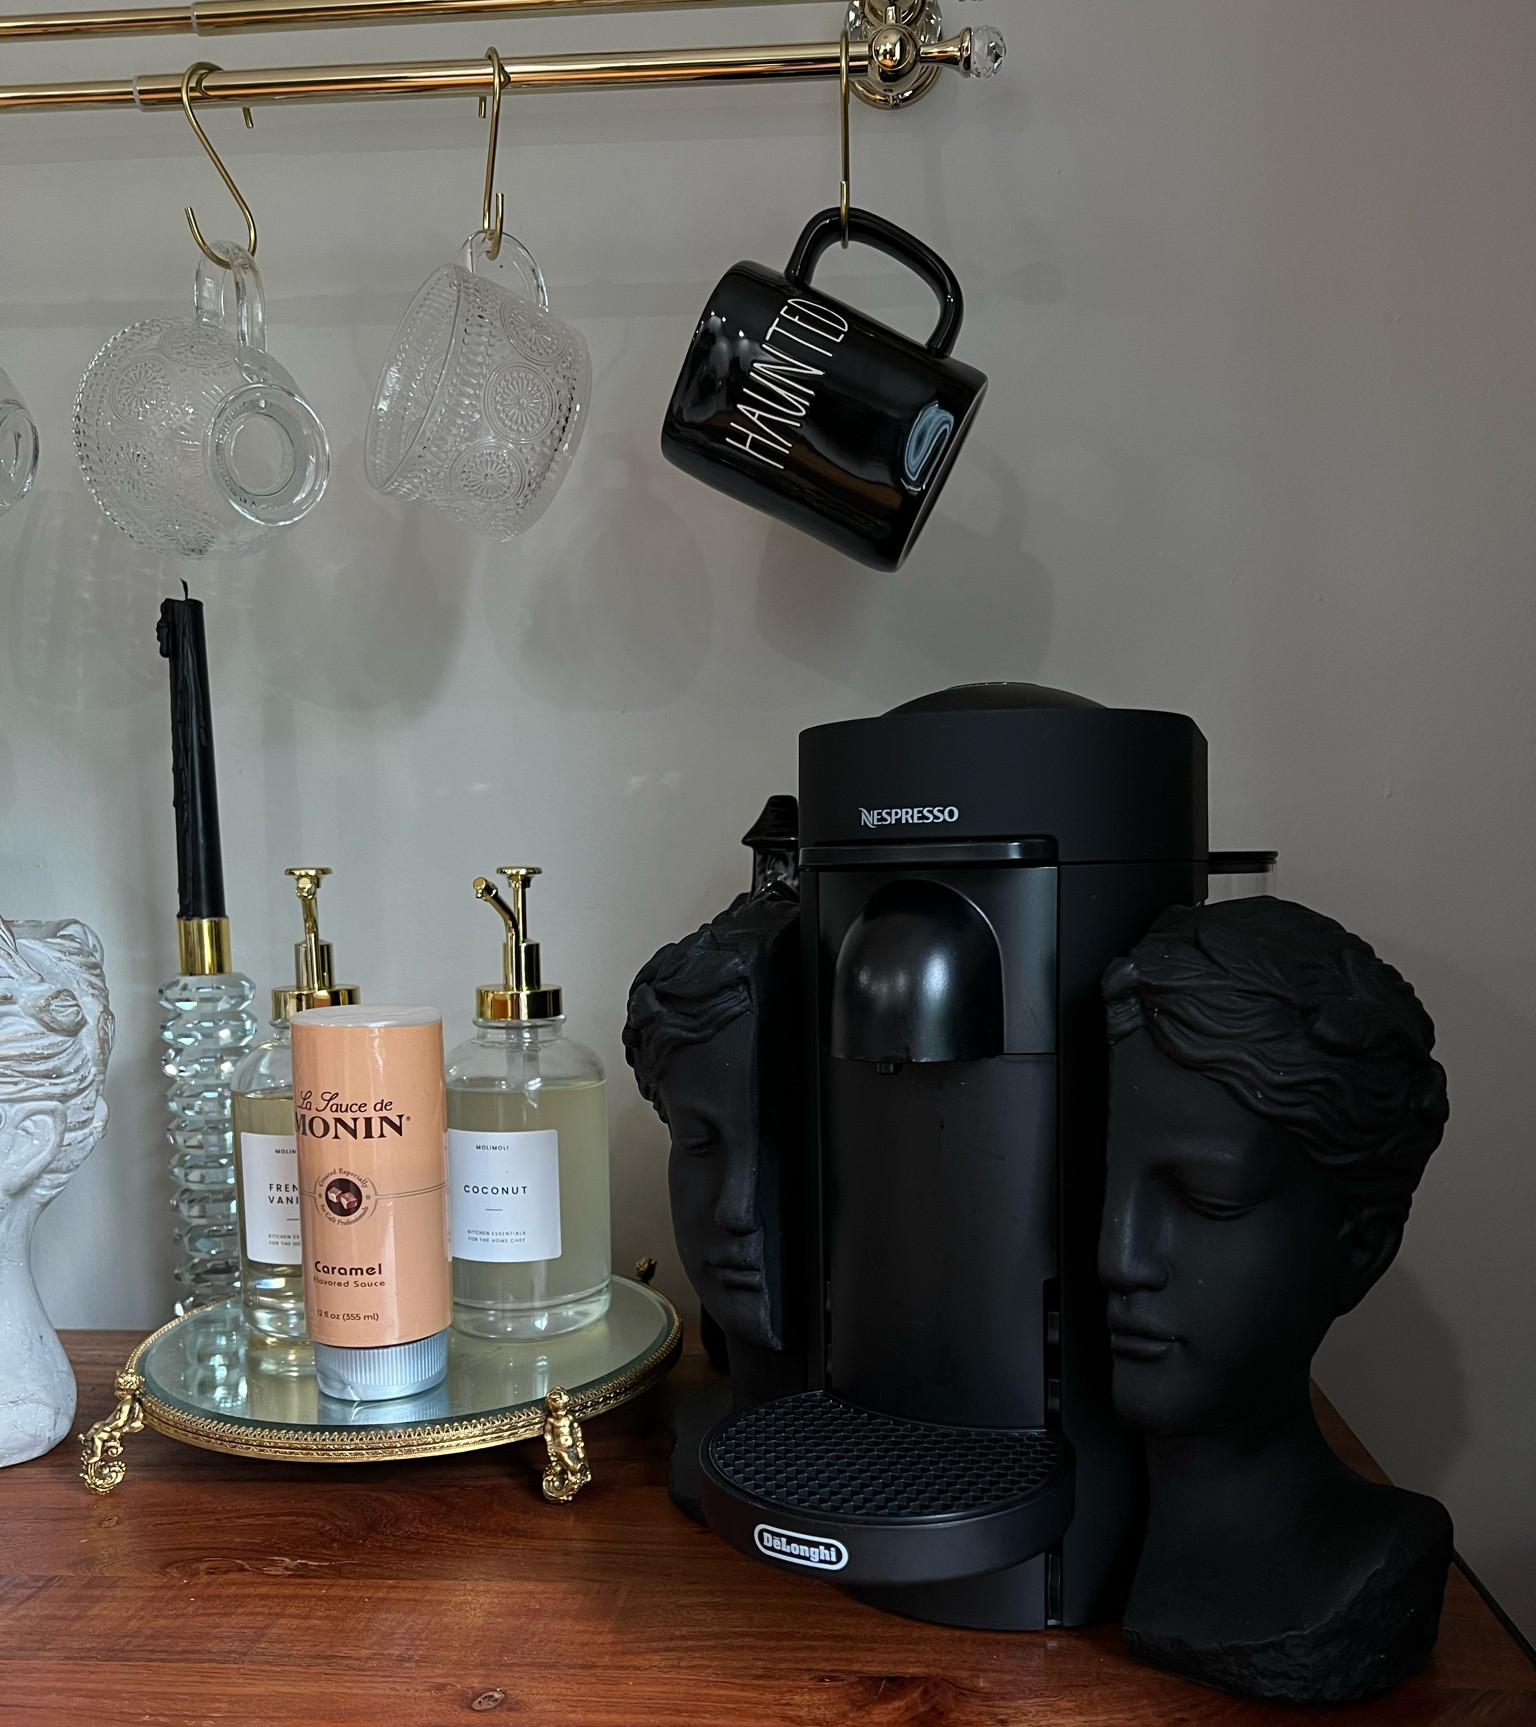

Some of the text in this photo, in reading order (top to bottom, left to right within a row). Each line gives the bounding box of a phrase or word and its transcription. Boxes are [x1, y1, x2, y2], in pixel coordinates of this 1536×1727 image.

[725, 298, 848, 470] HAUNTED
[858, 806, 959, 829] NESPRESSO
[297, 1090, 393, 1113] La Sauce de
[318, 1167, 369, 1189] Created Especially
[463, 1184, 528, 1195] COCONUT
[314, 1260, 382, 1276] Caramel
[313, 1275, 386, 1288] Flavored Sauce
[342, 1312, 361, 1322] (355
[363, 1312, 379, 1322] ml)
